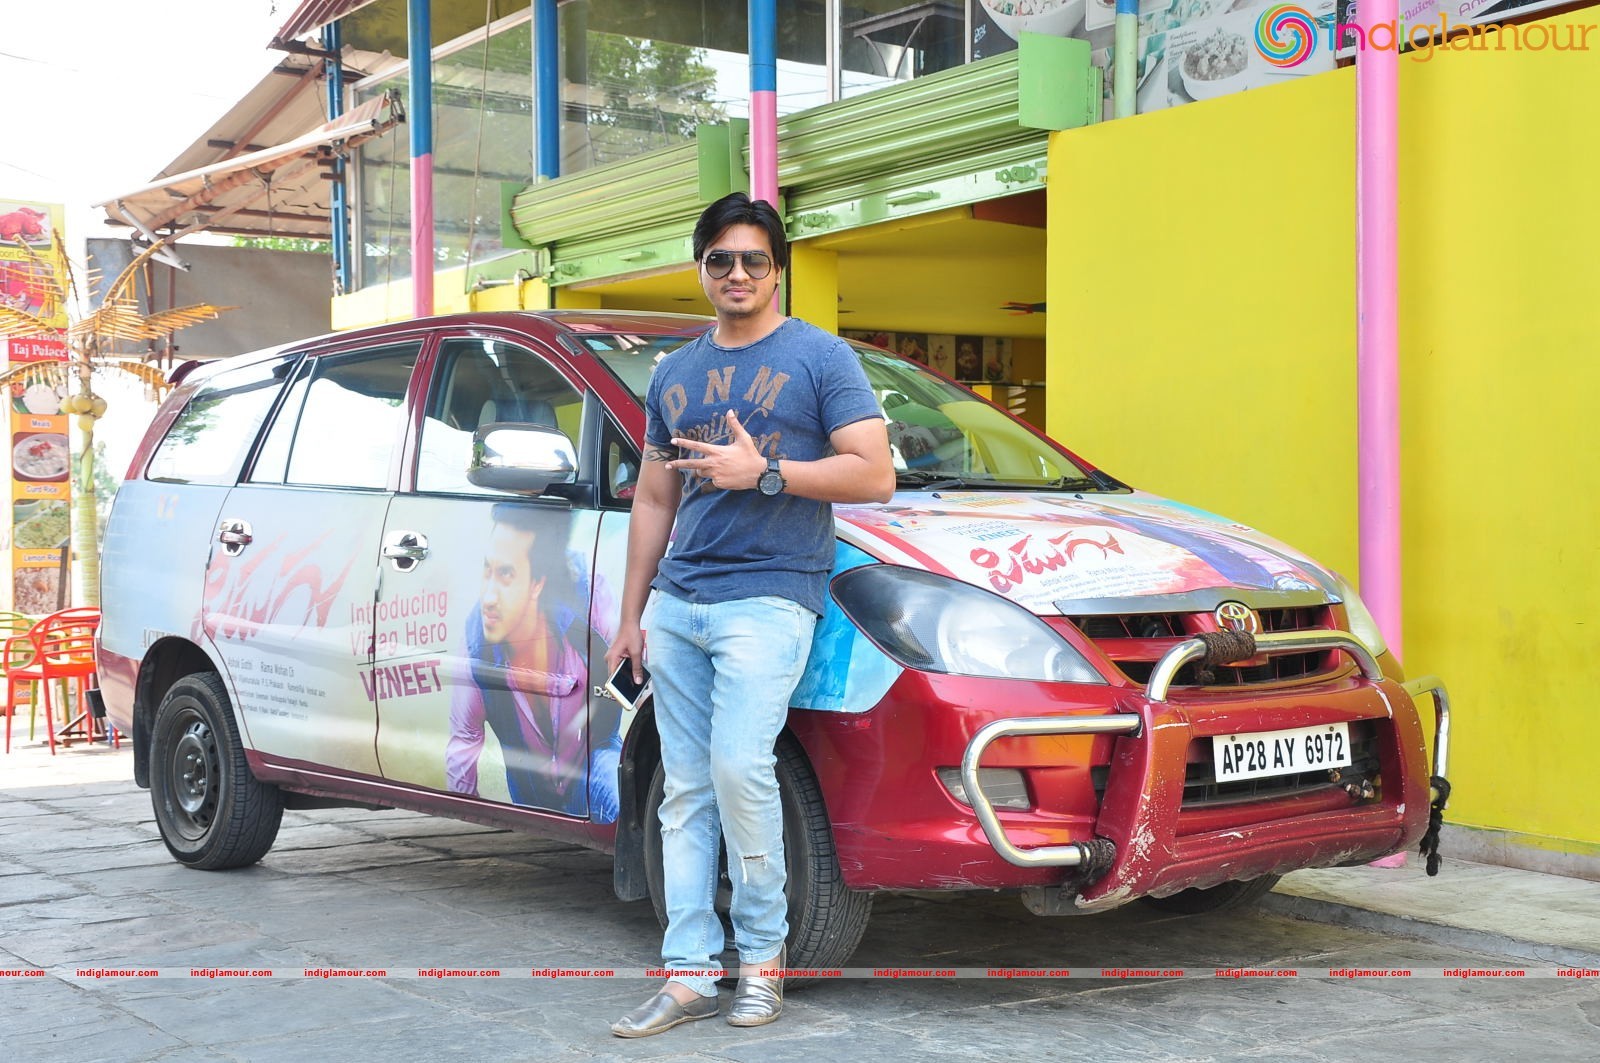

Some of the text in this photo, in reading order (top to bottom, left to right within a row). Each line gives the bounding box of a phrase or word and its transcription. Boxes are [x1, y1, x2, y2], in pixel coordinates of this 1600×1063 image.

[12, 343, 29, 358] Taj
[351, 588, 448, 625] Introducing
[406, 620, 447, 647] Hero
[1222, 732, 1345, 775] AP28 AY 6972
